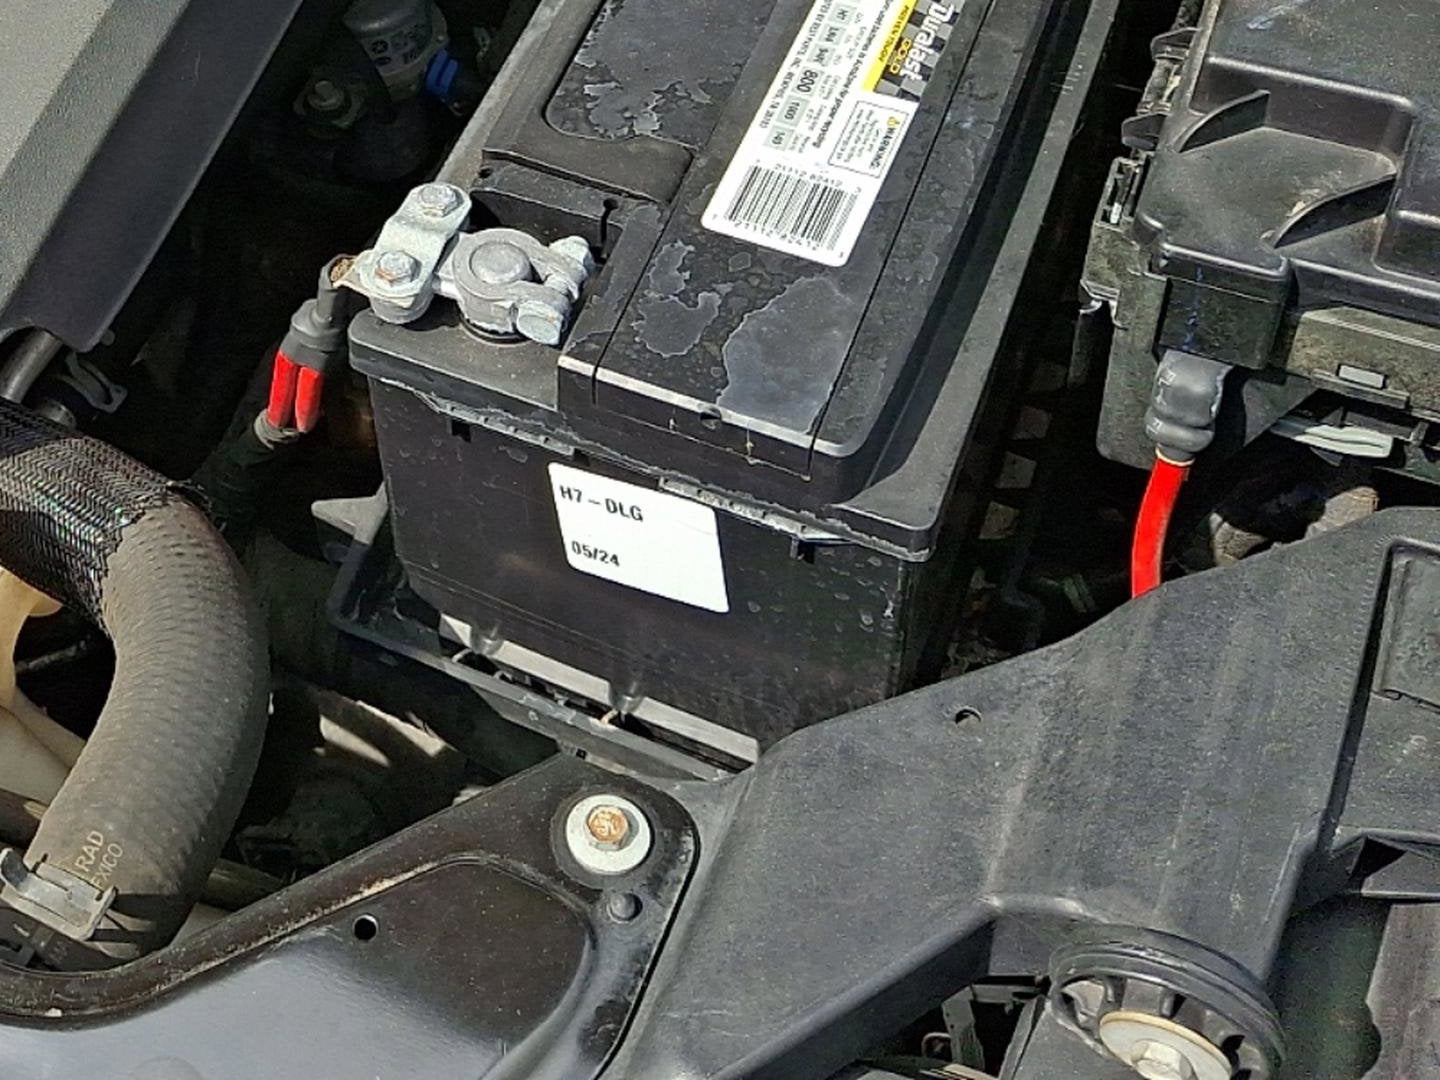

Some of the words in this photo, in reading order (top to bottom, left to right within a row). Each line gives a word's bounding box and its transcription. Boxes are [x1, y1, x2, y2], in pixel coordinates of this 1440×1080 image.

[888, 38, 912, 74] GOLD
[794, 68, 819, 94] 800
[604, 498, 644, 523] DLG
[571, 539, 621, 568] 05/24
[74, 830, 104, 872] RAD
[90, 843, 123, 889] EXICO
